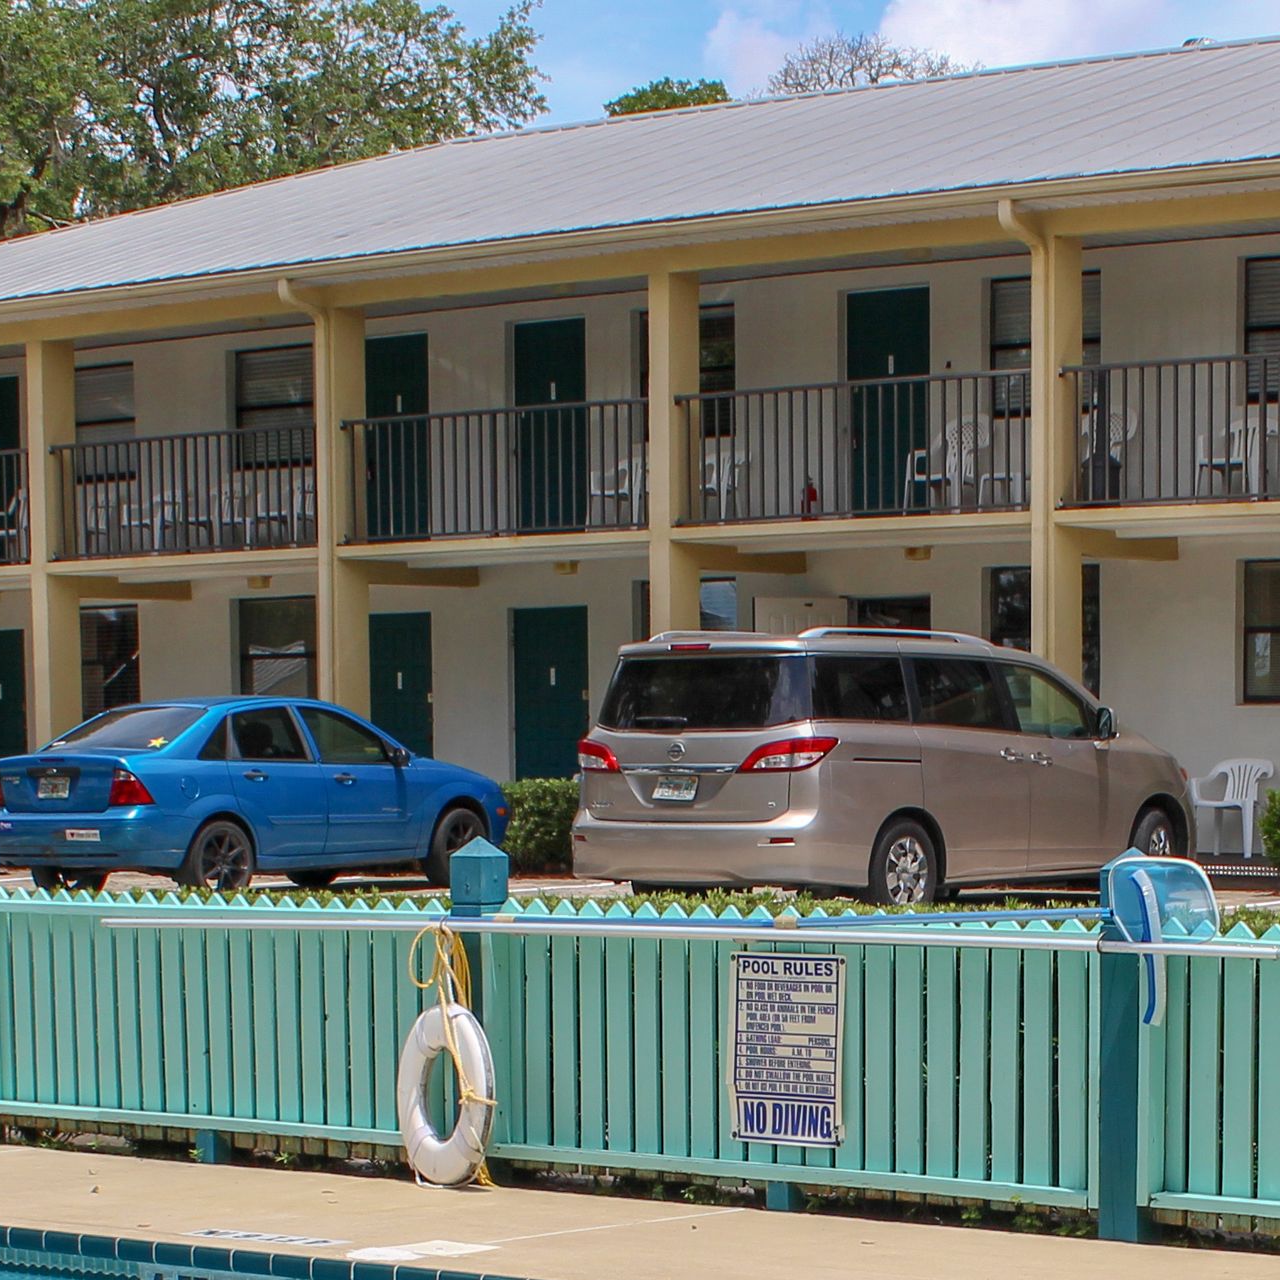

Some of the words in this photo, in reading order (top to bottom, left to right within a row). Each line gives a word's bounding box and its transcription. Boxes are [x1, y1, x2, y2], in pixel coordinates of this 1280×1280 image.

[742, 961, 778, 975] POOL
[784, 962, 833, 976] RULES
[746, 982, 753, 990] NO
[755, 982, 766, 990] FOOD
[775, 983, 802, 992] BEVERAGES
[804, 984, 810, 992] IN
[811, 984, 824, 993] POOL
[755, 992, 765, 1000] POOL
[767, 993, 777, 1001] WET
[754, 1004, 768, 1012] GLASS
[777, 1004, 799, 1013] ANIMALS
[808, 1006, 816, 1014] THE
[746, 1013, 757, 1021] POOL
[759, 1013, 770, 1021] AREA
[789, 1015, 800, 1023] FEET
[766, 1071, 791, 1080] SWALLOW
[743, 1101, 767, 1133] NO
[772, 1103, 832, 1138] DIVING
